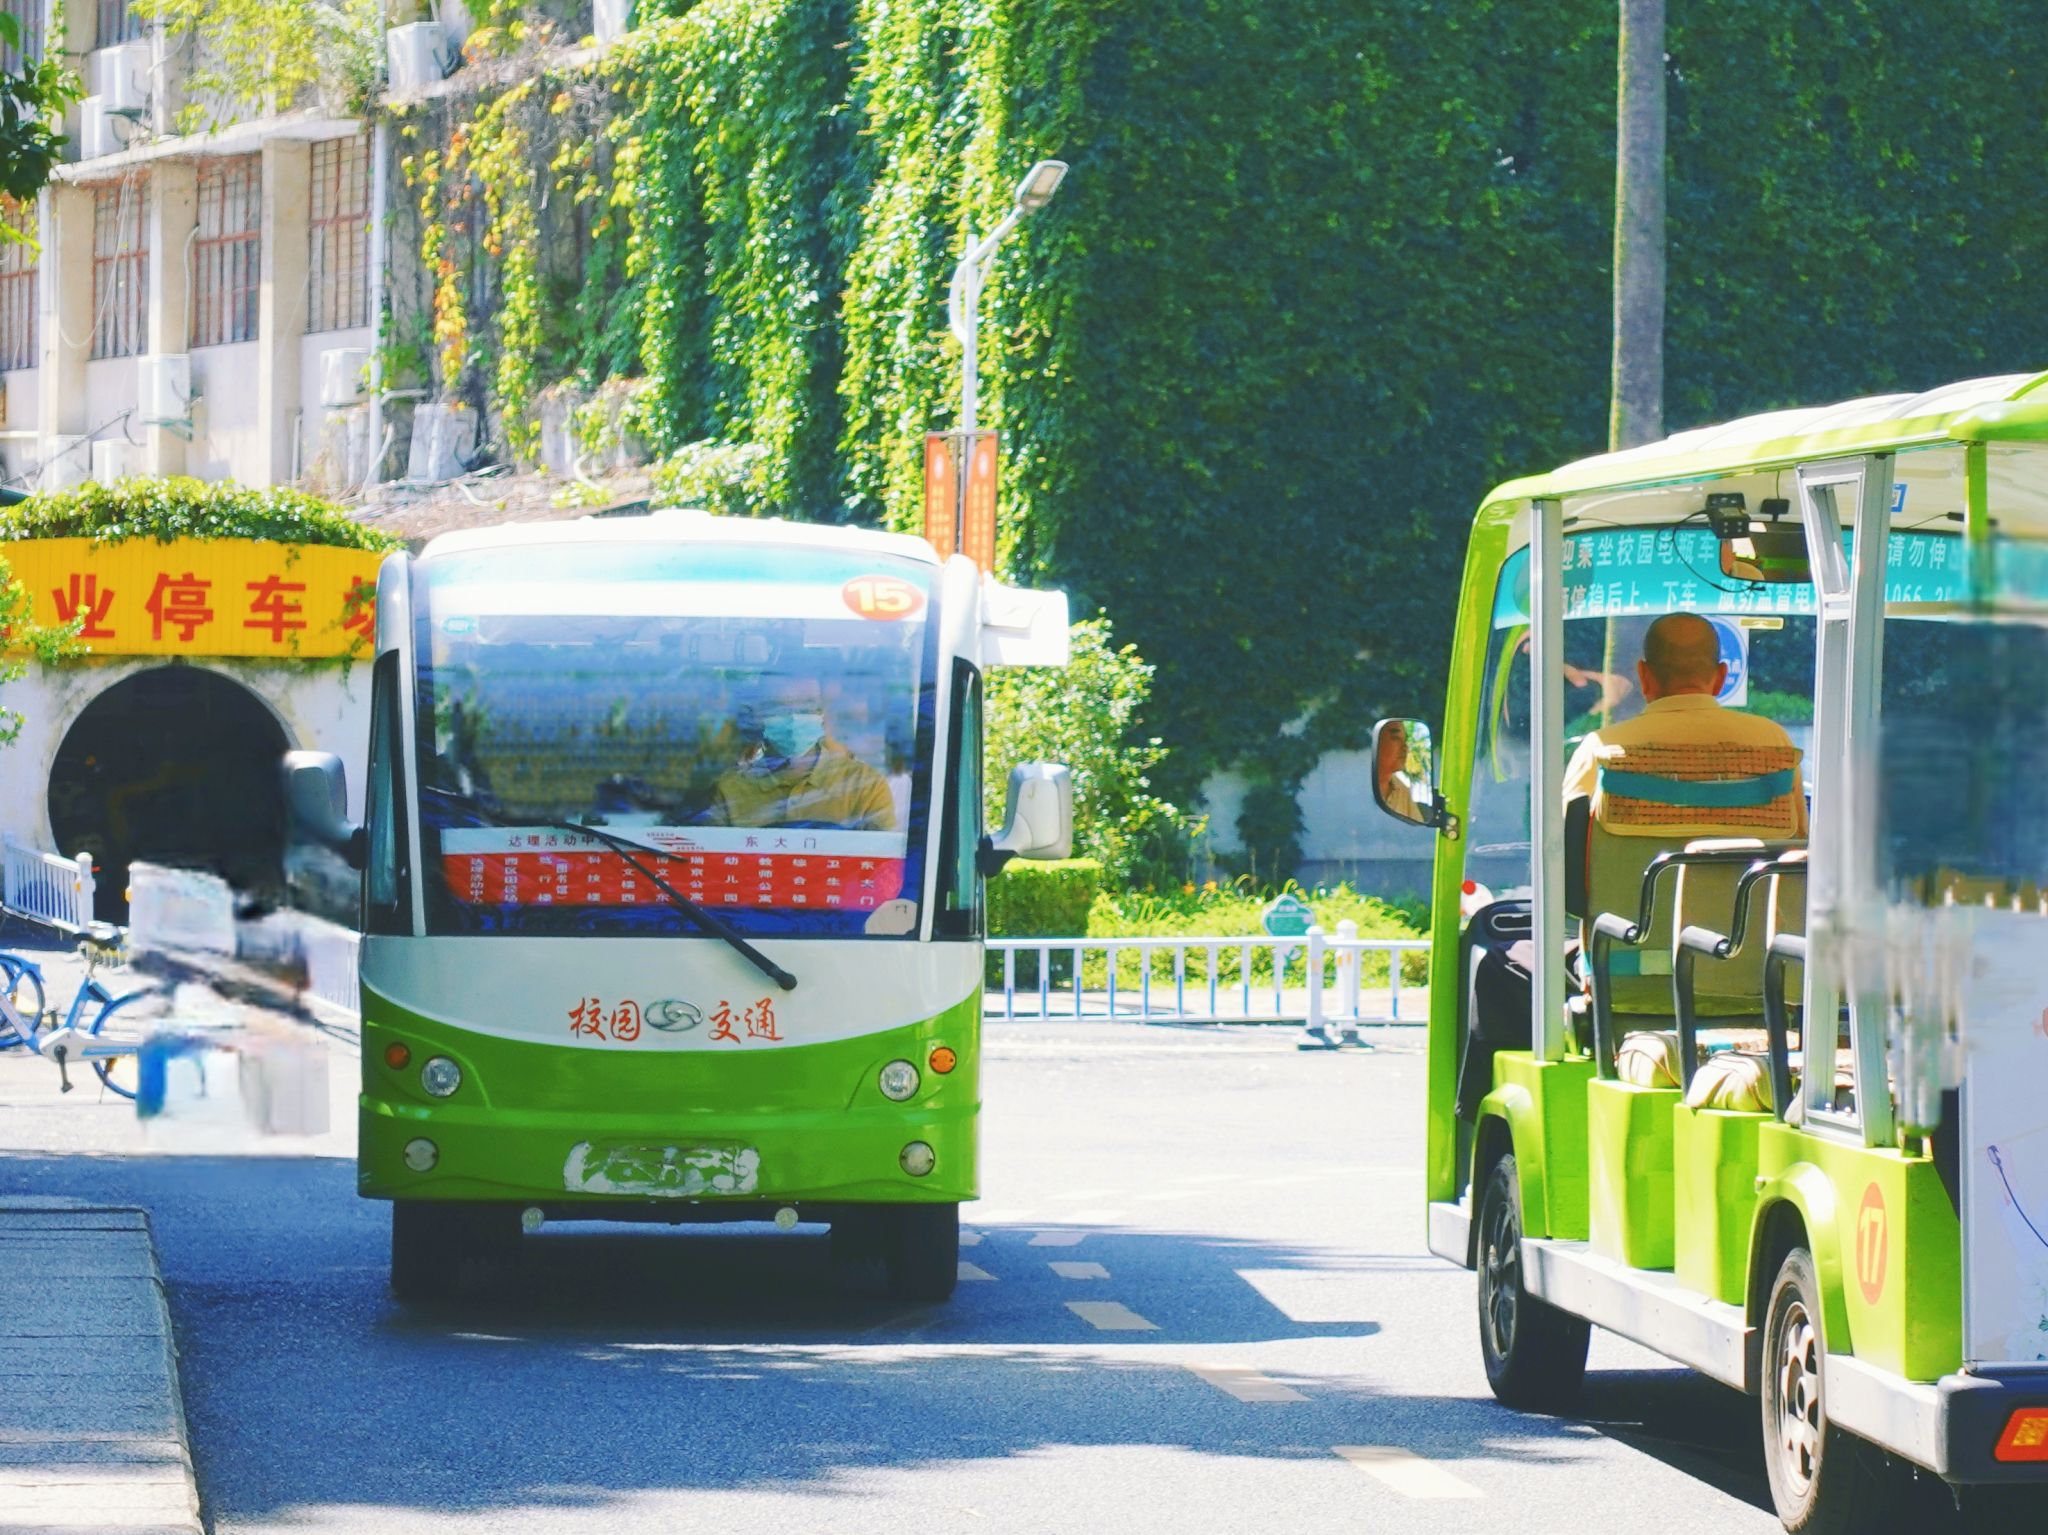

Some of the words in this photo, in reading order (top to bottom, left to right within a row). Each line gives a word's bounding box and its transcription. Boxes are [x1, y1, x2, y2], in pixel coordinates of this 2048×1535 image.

[1887, 536, 1960, 570] 请勿伸
[848, 581, 912, 612] 15
[1717, 580, 1818, 612] 服务监督电
[508, 834, 608, 848] 达理活动中
[745, 836, 817, 849] 东大门
[860, 861, 875, 905] 东大门
[568, 997, 641, 1041] 校园
[708, 998, 784, 1044] 交通
[1859, 1206, 1885, 1285] 17
